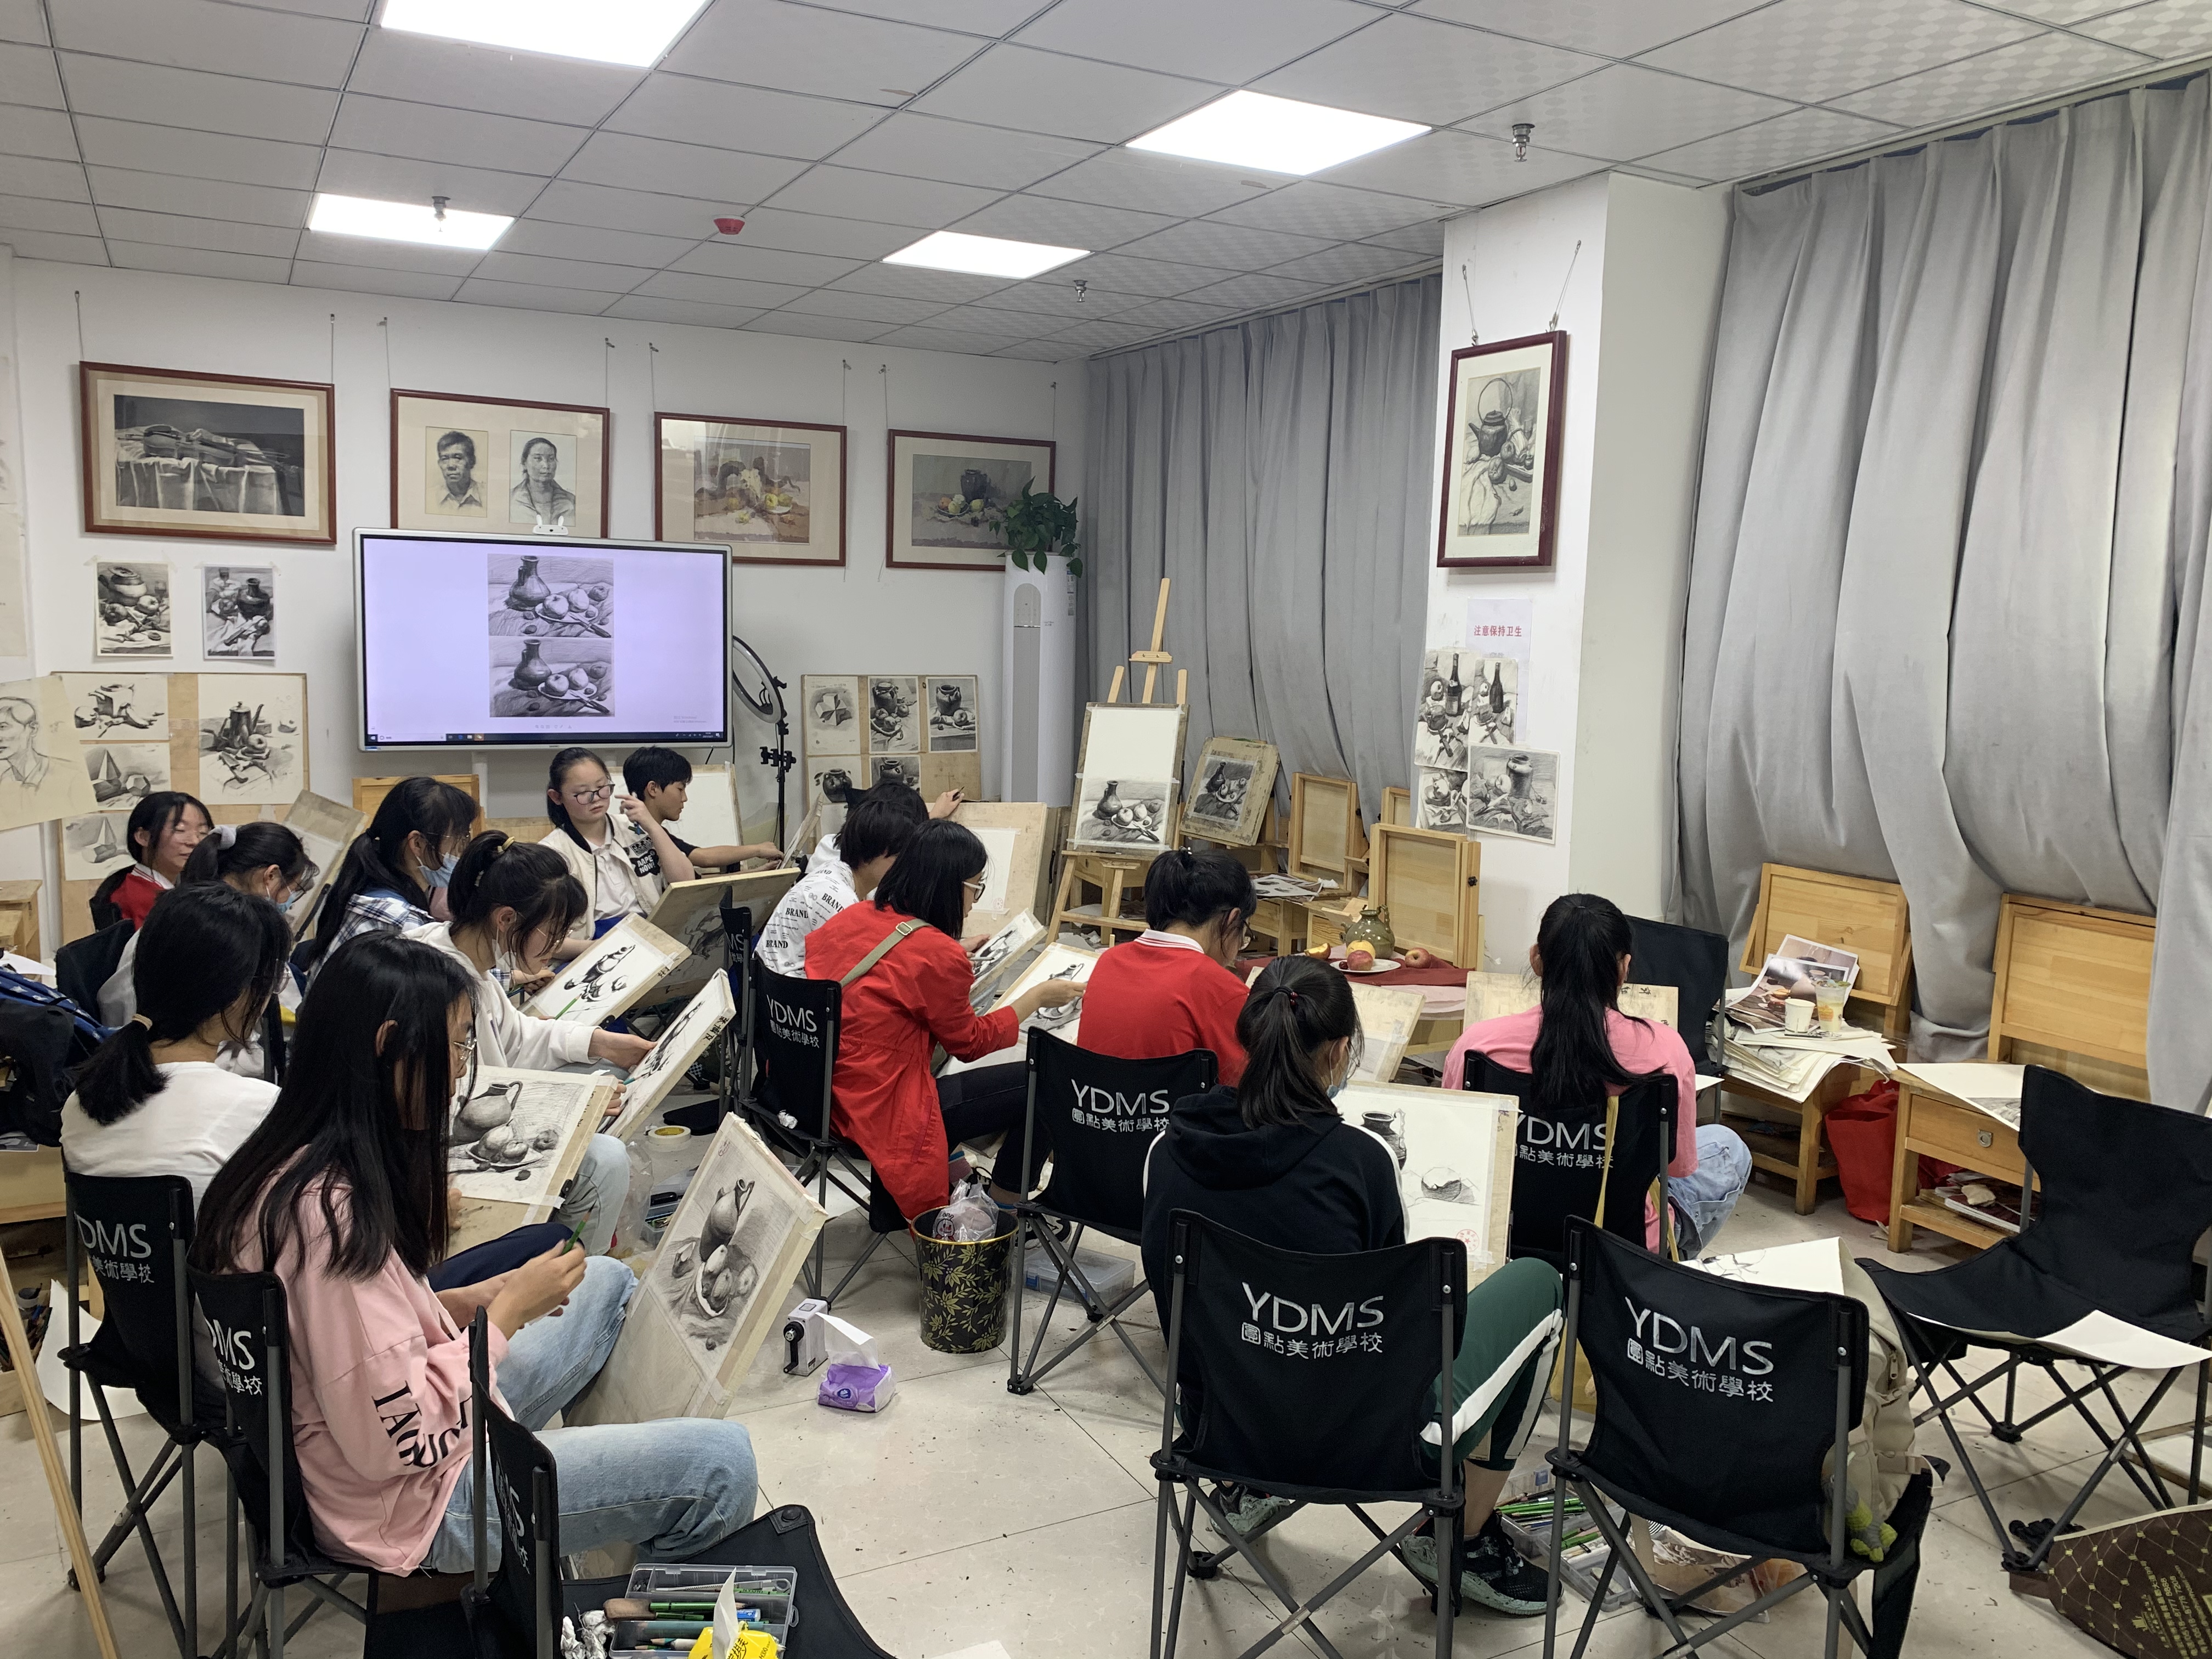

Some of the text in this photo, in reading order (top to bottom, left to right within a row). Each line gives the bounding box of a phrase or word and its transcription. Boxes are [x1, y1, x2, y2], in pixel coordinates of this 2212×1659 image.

[1474, 625, 1522, 637] 注意保持卫生
[637, 855, 653, 867] AAPE
[639, 862, 656, 874] NOW!
[785, 907, 809, 919] BRAND
[766, 940, 788, 949] BRAND
[766, 994, 817, 1032] YDMS
[1071, 1079, 1170, 1116] YDMS
[1517, 1114, 1615, 1150] DMS
[1242, 1282, 1384, 1335] YDMS
[1625, 1296, 1774, 1375] YDMS
